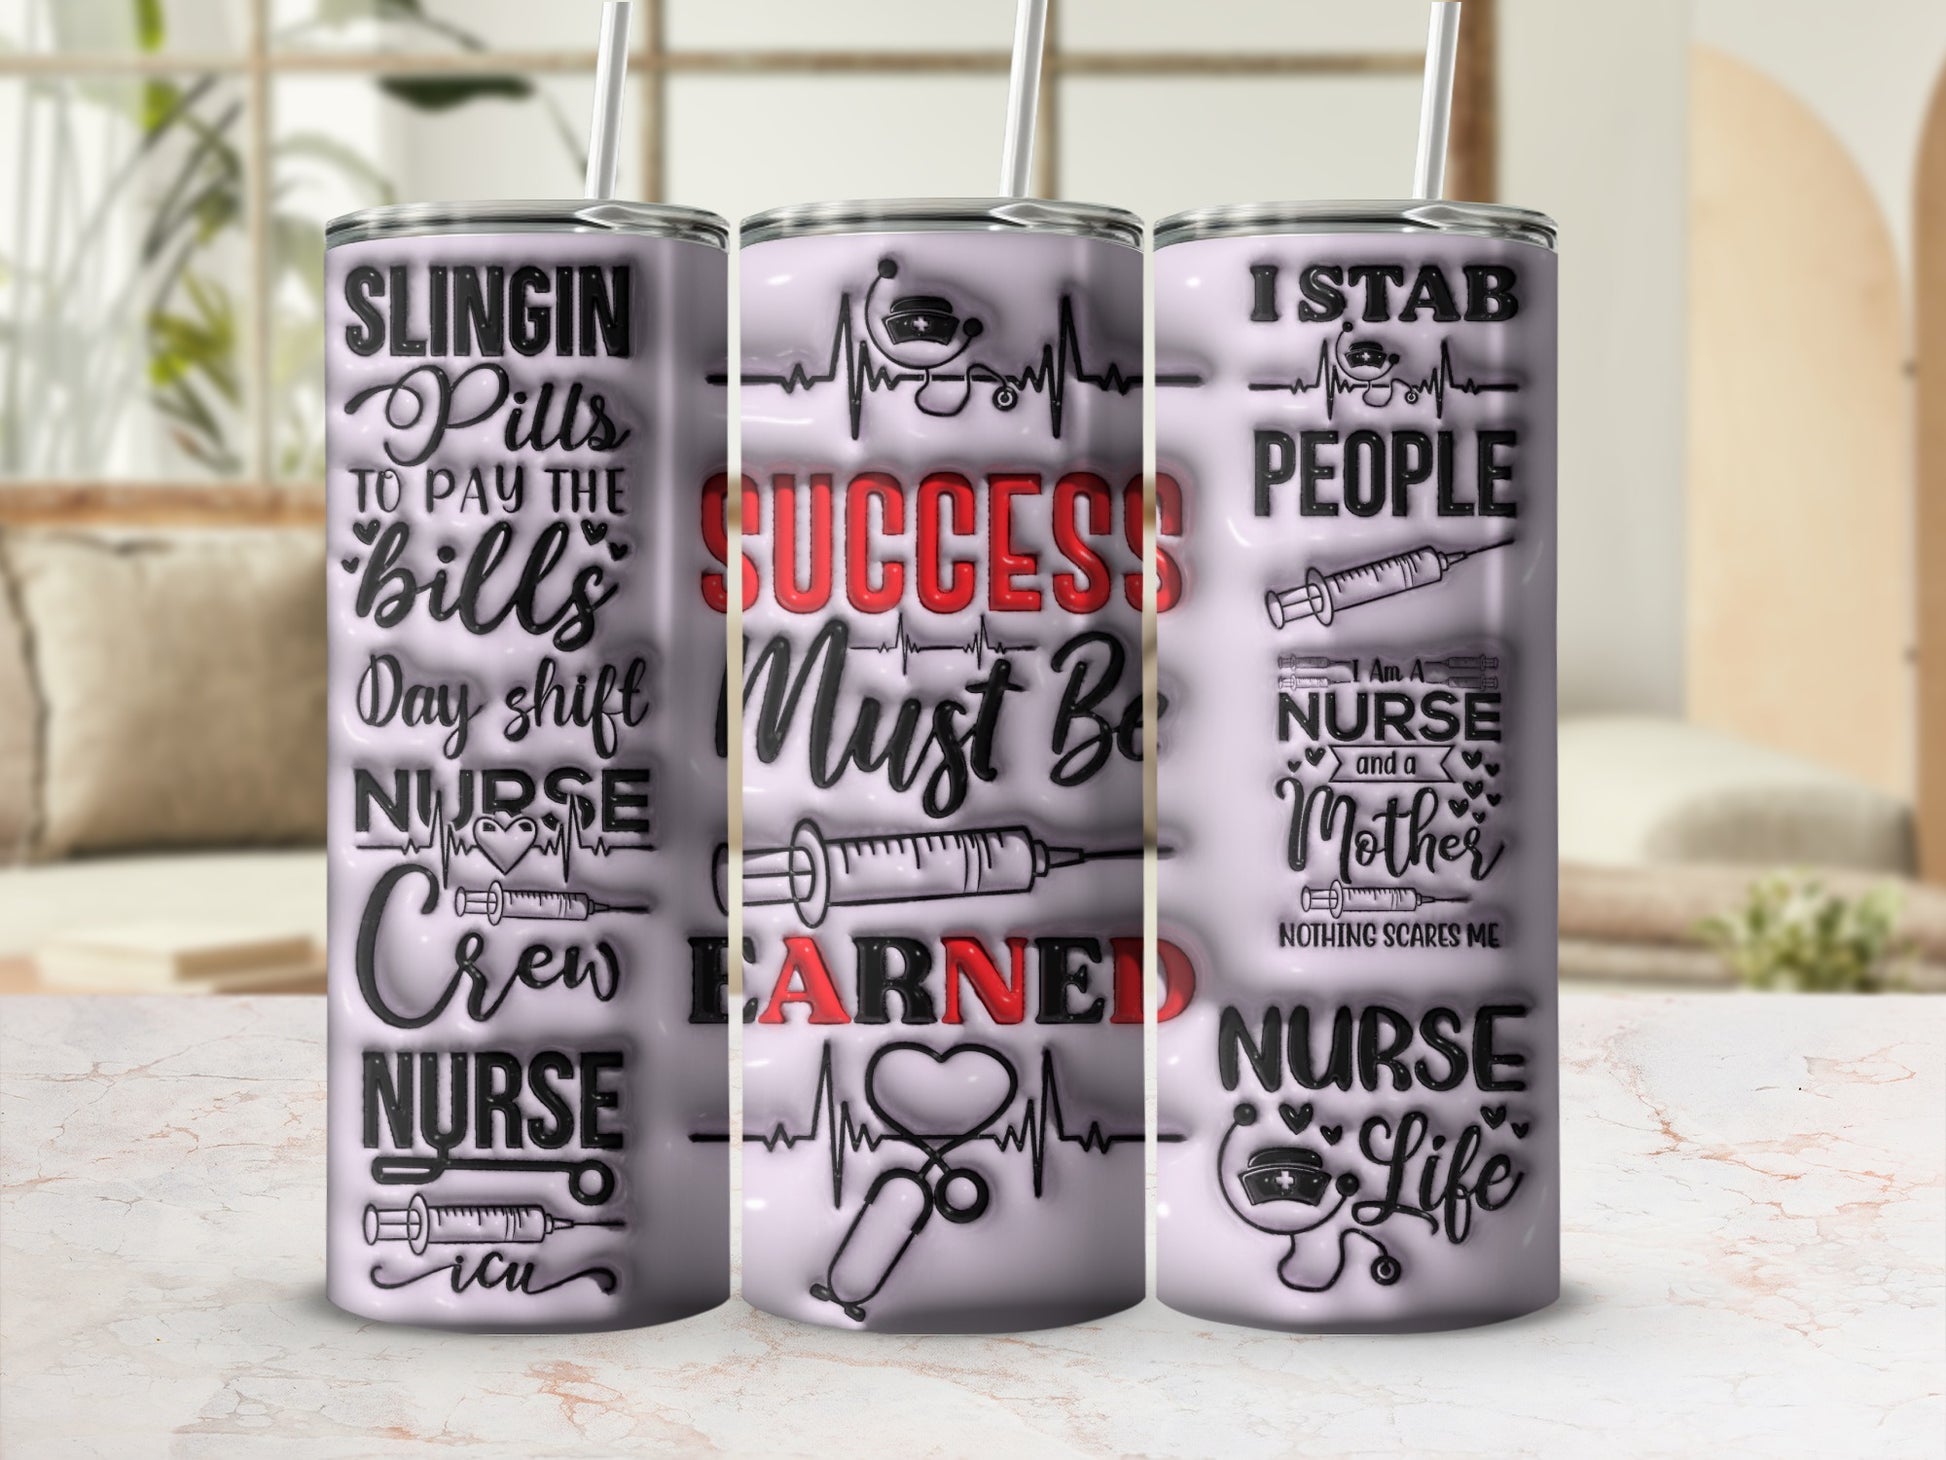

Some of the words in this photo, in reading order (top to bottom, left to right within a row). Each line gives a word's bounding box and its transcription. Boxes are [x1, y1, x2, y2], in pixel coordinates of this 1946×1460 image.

[344, 265, 630, 358] SLINGIN
[1249, 265, 1279, 322] I
[1298, 265, 1519, 322] STAB
[344, 362, 631, 467] Pills
[348, 468, 401, 513] TO
[426, 466, 524, 514] PAY
[543, 468, 626, 514] THE
[1254, 430, 1517, 517] PEOPLE
[355, 521, 620, 651] bills
[701, 471, 1184, 614] SUCCESS
[356, 653, 485, 760] Day
[503, 656, 650, 760] shift
[1369, 657, 1402, 683] Am
[1409, 658, 1426, 683] A
[715, 617, 1026, 818] Must
[1048, 631, 1168, 787] Be
[1278, 690, 1503, 742] NURSE
[354, 767, 651, 833] NURSE
[1356, 751, 1397, 775] and
[1404, 757, 1417, 775] a
[1275, 777, 1506, 885] Mother
[355, 863, 620, 1029] Crew
[687, 935, 1197, 1025] EARNED
[1278, 922, 1377, 948] NOTHING
[1383, 922, 1461, 948] SCARES
[1467, 923, 1501, 948] ME
[1217, 1005, 1529, 1093] NURSE
[362, 1050, 625, 1150] NURSE
[1351, 1111, 1526, 1245] Life
